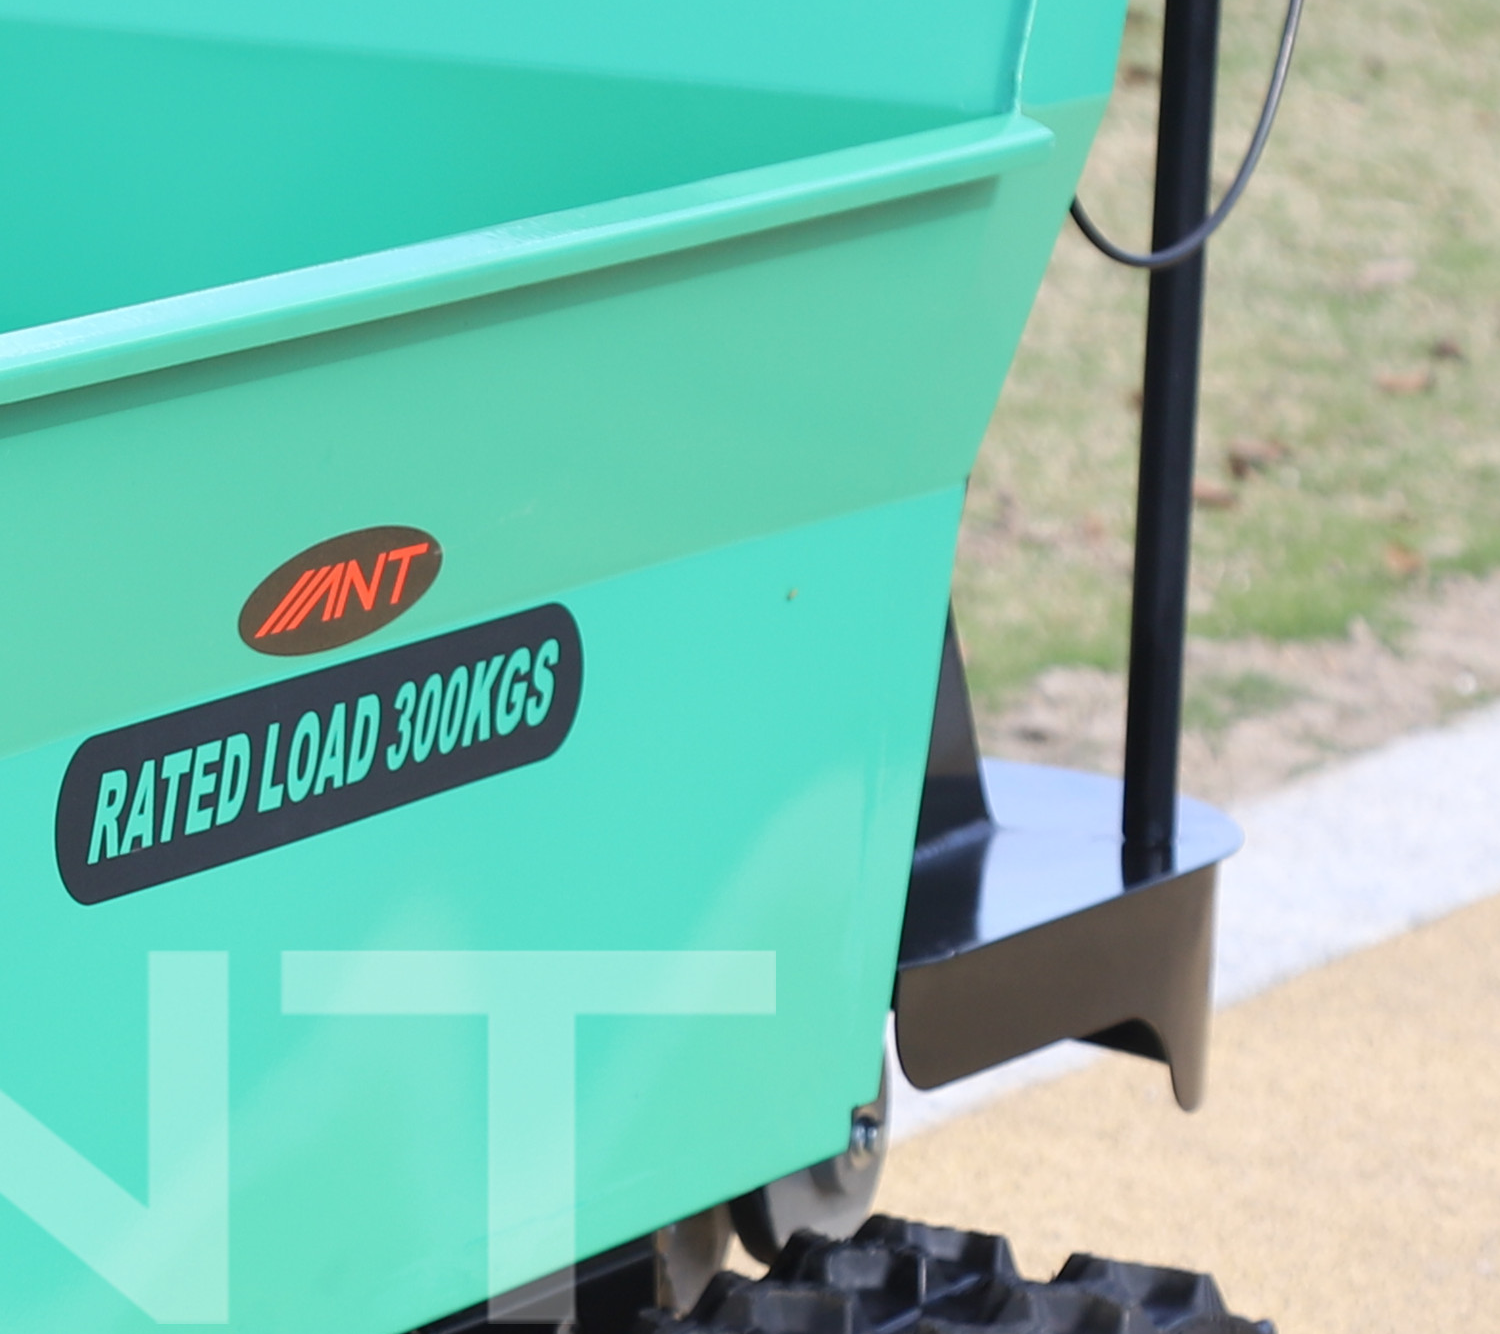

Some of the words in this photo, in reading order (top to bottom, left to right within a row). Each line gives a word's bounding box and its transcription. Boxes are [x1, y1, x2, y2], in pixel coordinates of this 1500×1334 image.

[254, 542, 429, 639] ANT
[87, 732, 252, 865] RATED
[257, 693, 381, 813] LOAD
[386, 638, 559, 771] 300KGS
